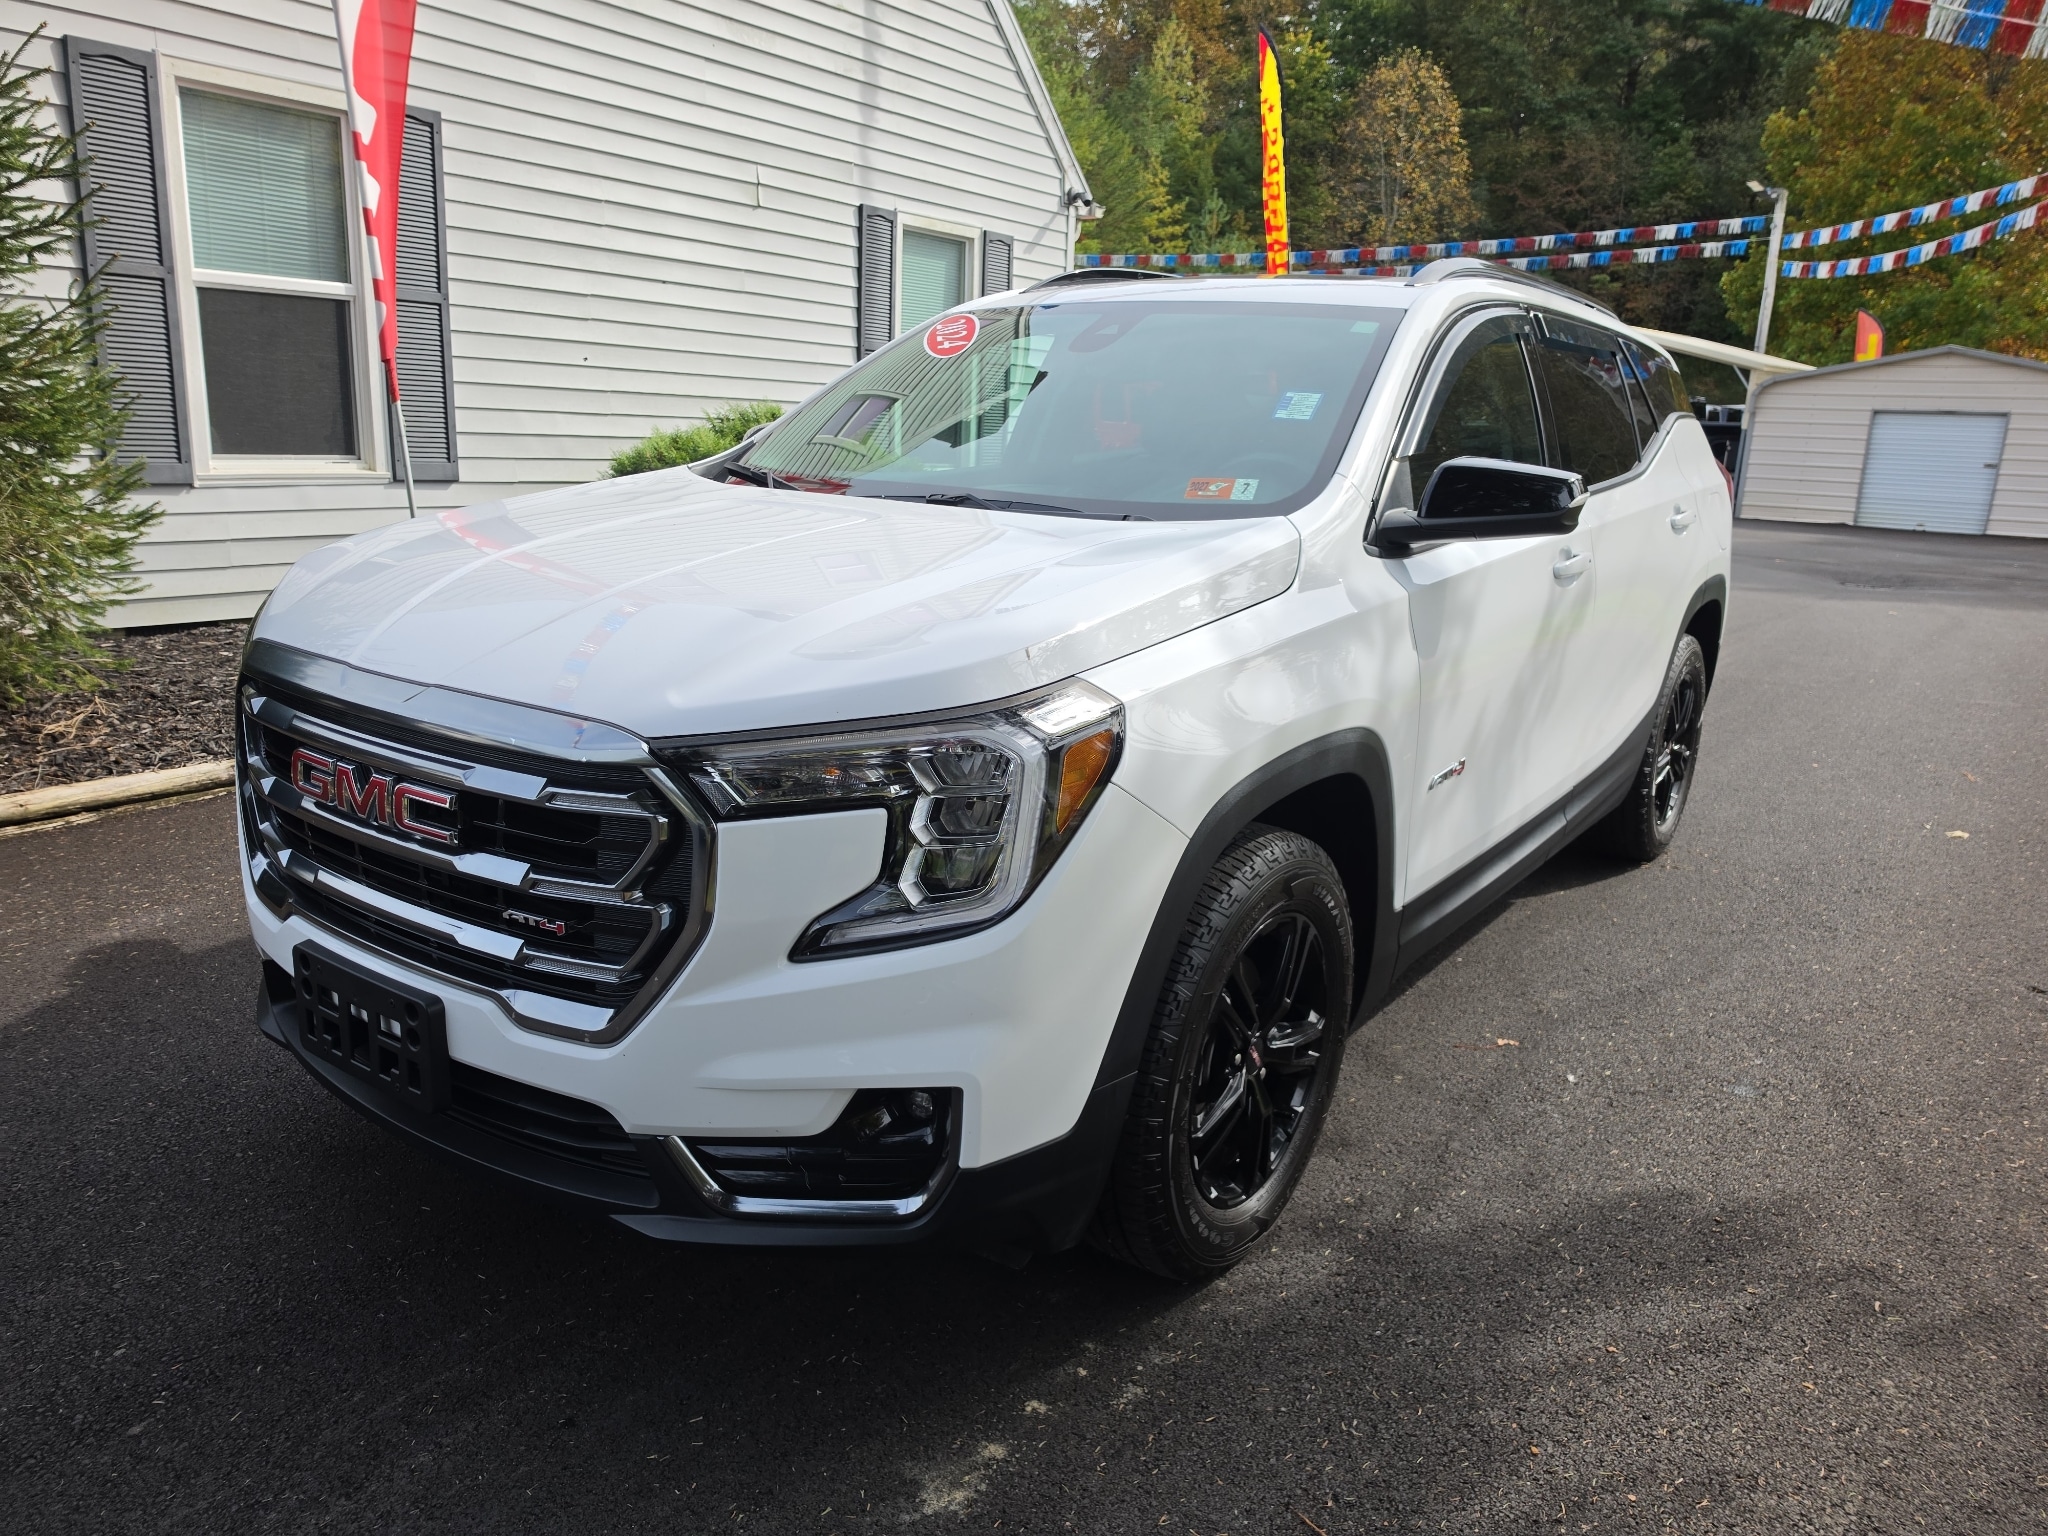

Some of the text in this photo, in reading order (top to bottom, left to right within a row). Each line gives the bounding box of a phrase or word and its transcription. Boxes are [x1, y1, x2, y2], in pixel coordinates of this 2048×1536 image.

[936, 319, 970, 349] 2024
[1188, 481, 1210, 493] 2027
[1241, 482, 1251, 495] 7
[291, 748, 459, 847] GMC
[502, 909, 566, 936] AT4
